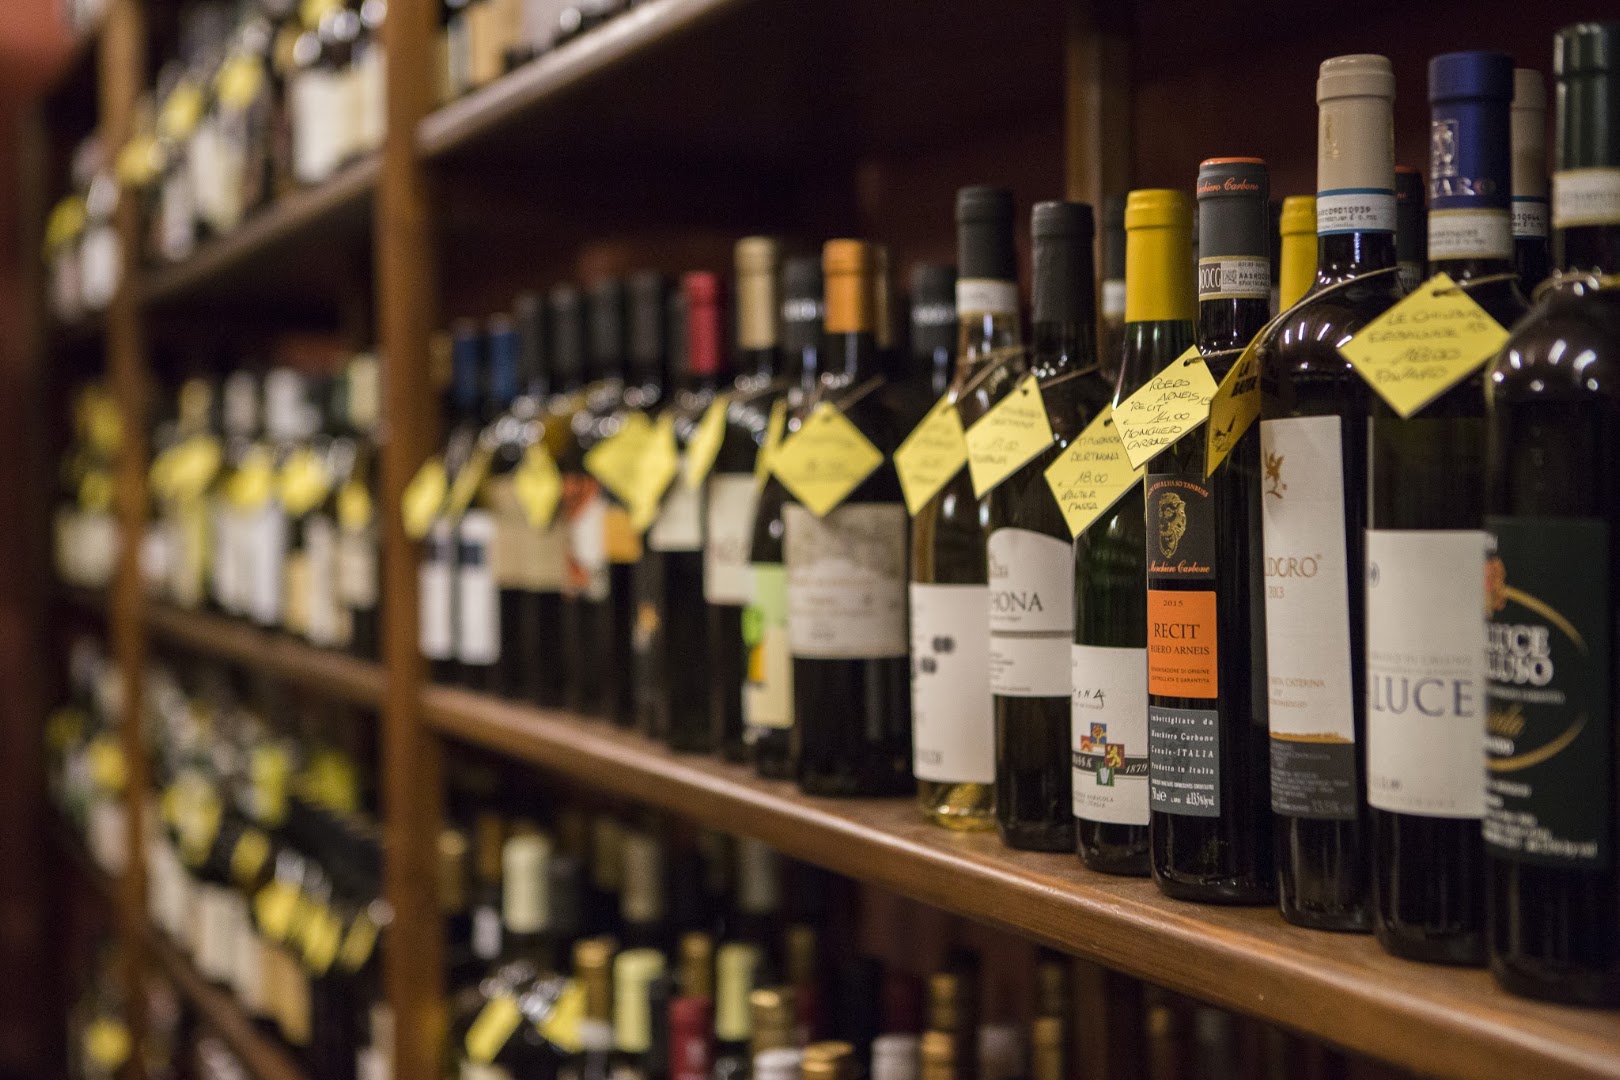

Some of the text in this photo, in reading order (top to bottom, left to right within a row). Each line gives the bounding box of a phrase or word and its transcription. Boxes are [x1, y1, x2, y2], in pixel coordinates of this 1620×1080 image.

[1224, 177, 1260, 191] Carbone
[1149, 378, 1190, 391] ROERO
[1156, 391, 1199, 403] ARNEIS
[1123, 425, 1182, 439] MONCHIERO
[1178, 560, 1210, 573] Carbone
[1154, 623, 1200, 639] RECIT
[1150, 645, 1210, 656] ROERO ARNEIS
[1150, 715, 1214, 726] Imbottigliato da
[1151, 729, 1214, 742] Monchiero Carbone
[1125, 763, 1147, 773] 1879
[1151, 762, 1174, 772] Prodotto
[1189, 767, 1214, 775] Italia
